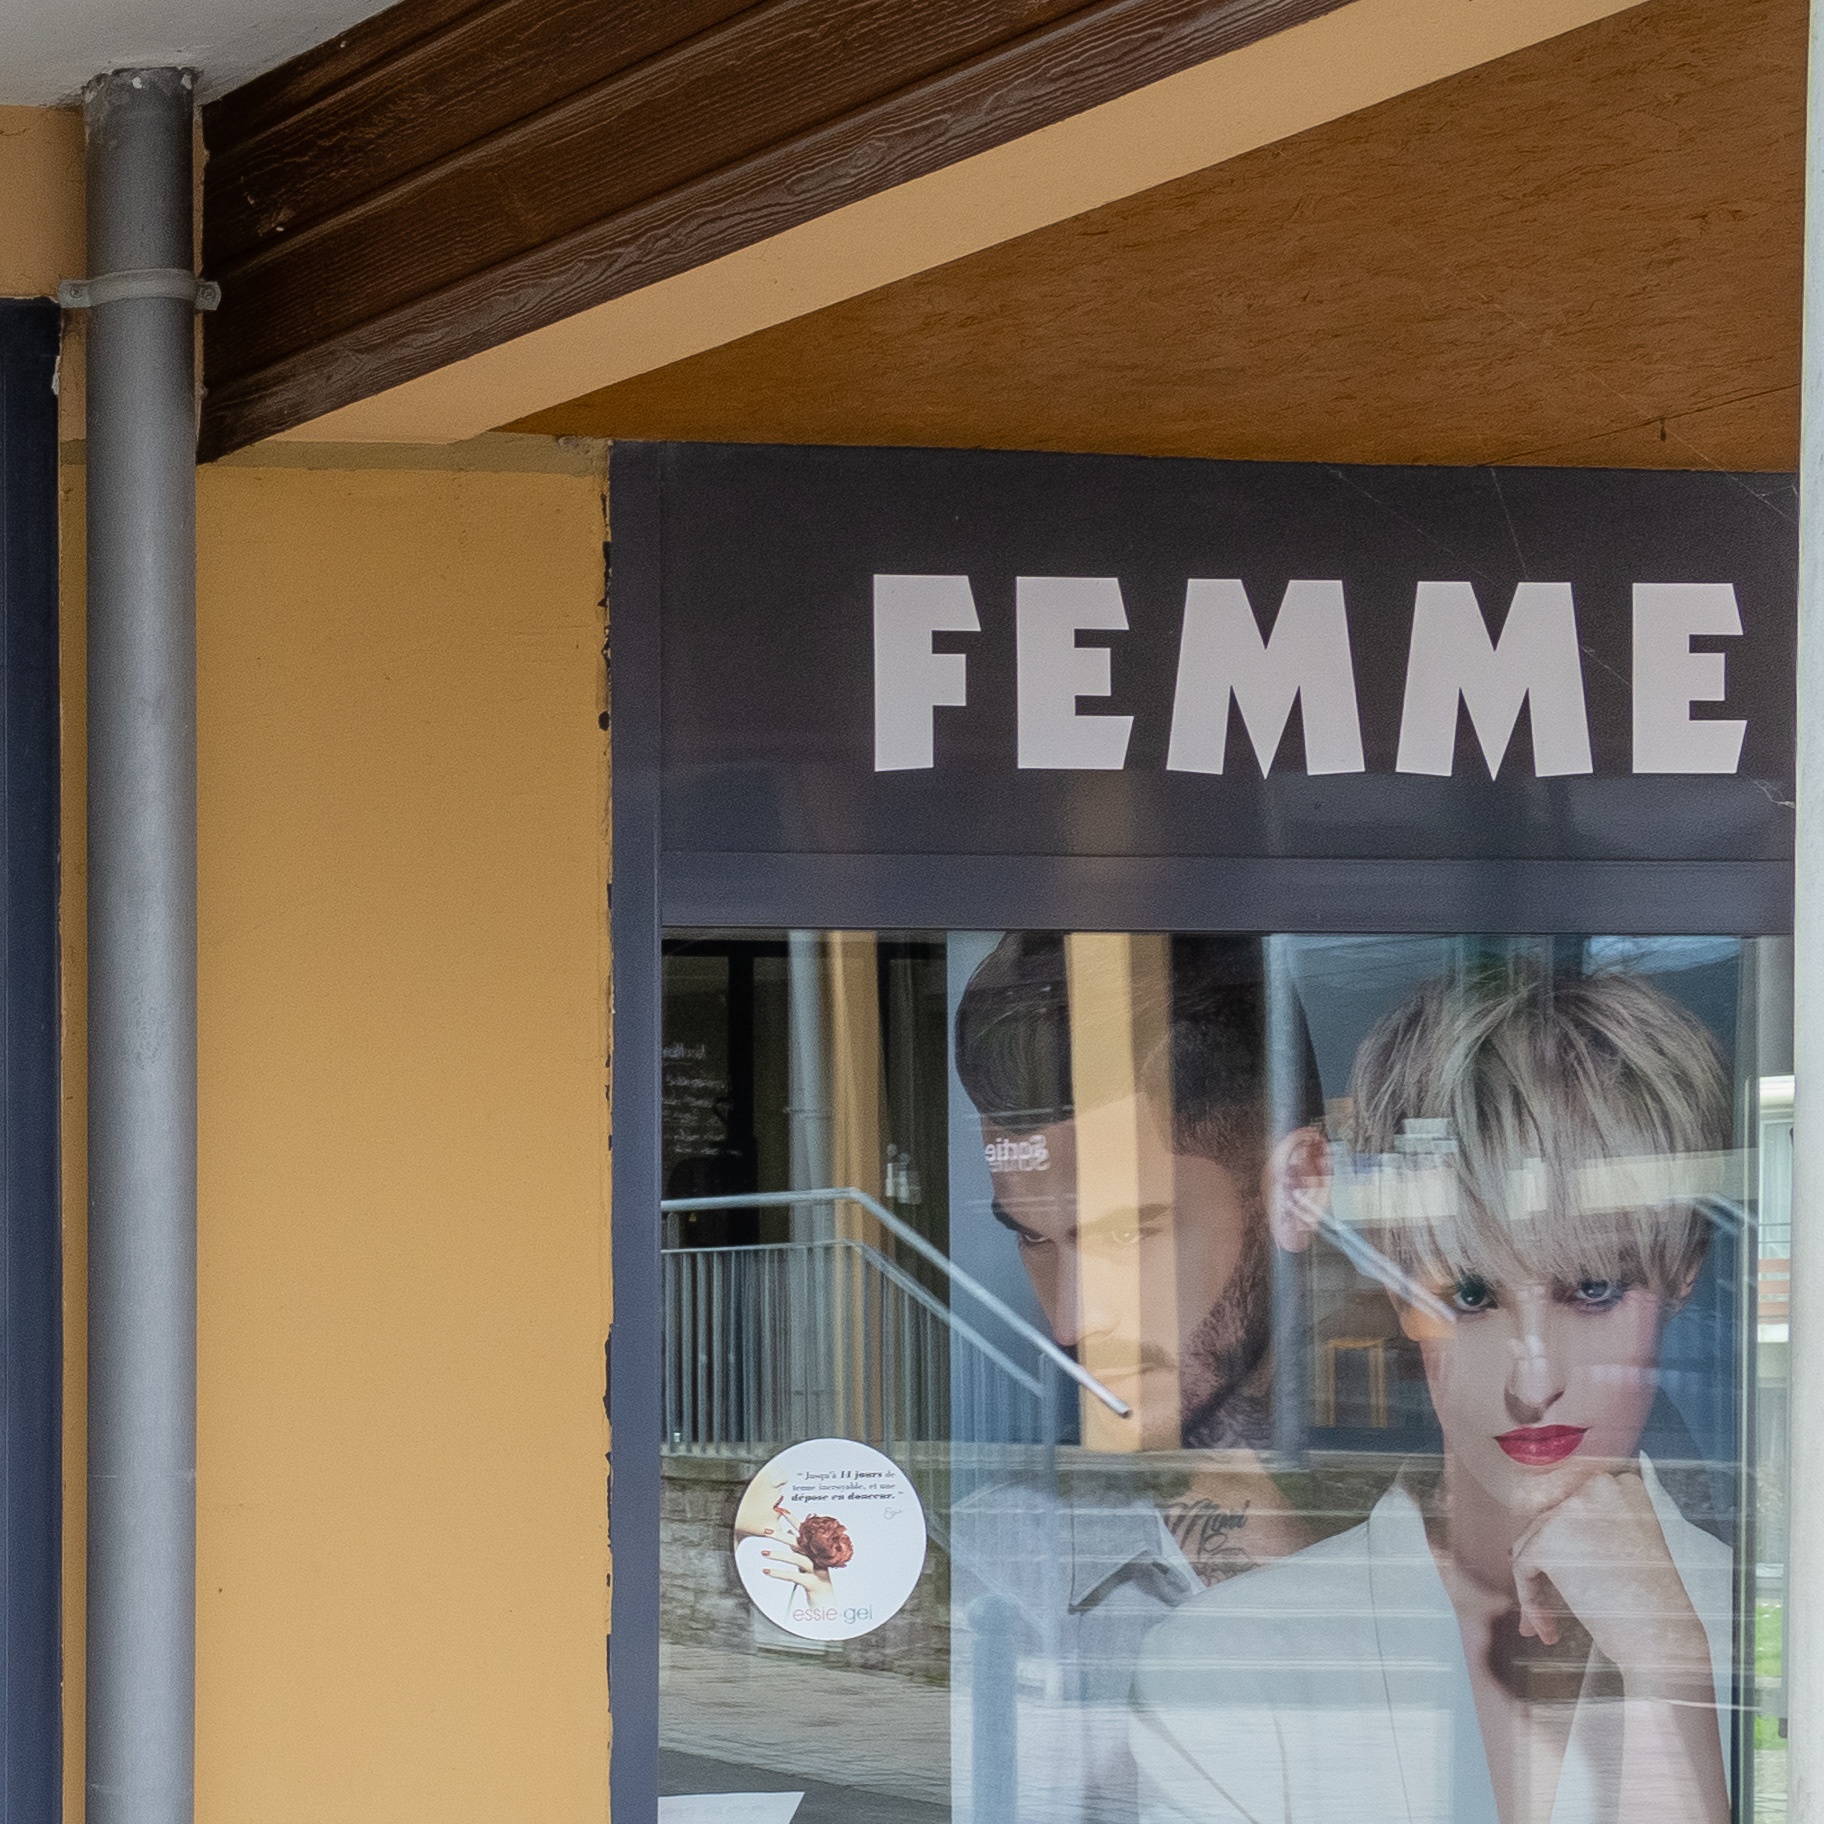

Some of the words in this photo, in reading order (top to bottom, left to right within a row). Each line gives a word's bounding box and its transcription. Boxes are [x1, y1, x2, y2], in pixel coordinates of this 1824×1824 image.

[872, 573, 1750, 781] FEMME
[792, 1606, 838, 1622] essie
[843, 1604, 873, 1624] gel
